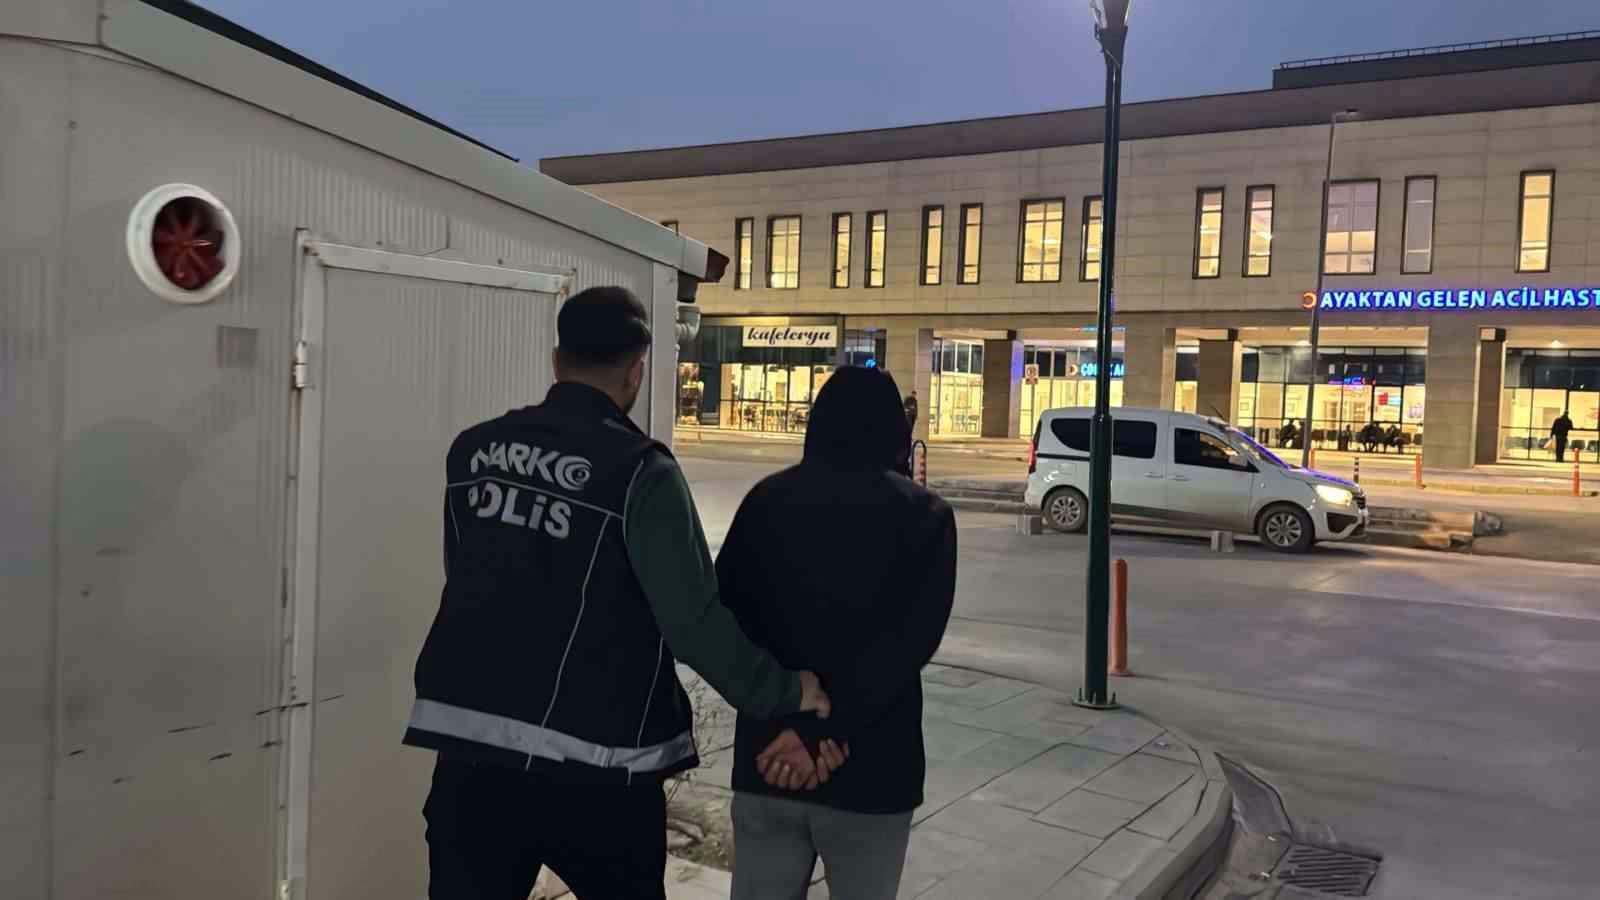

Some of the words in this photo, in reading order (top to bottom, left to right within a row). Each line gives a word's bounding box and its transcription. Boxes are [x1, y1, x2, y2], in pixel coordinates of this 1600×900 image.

[1320, 291, 1412, 309] AYAKTAN
[1417, 289, 1486, 309] GELEN
[1491, 286, 1540, 307] ACİL
[747, 327, 831, 345] kafeterya
